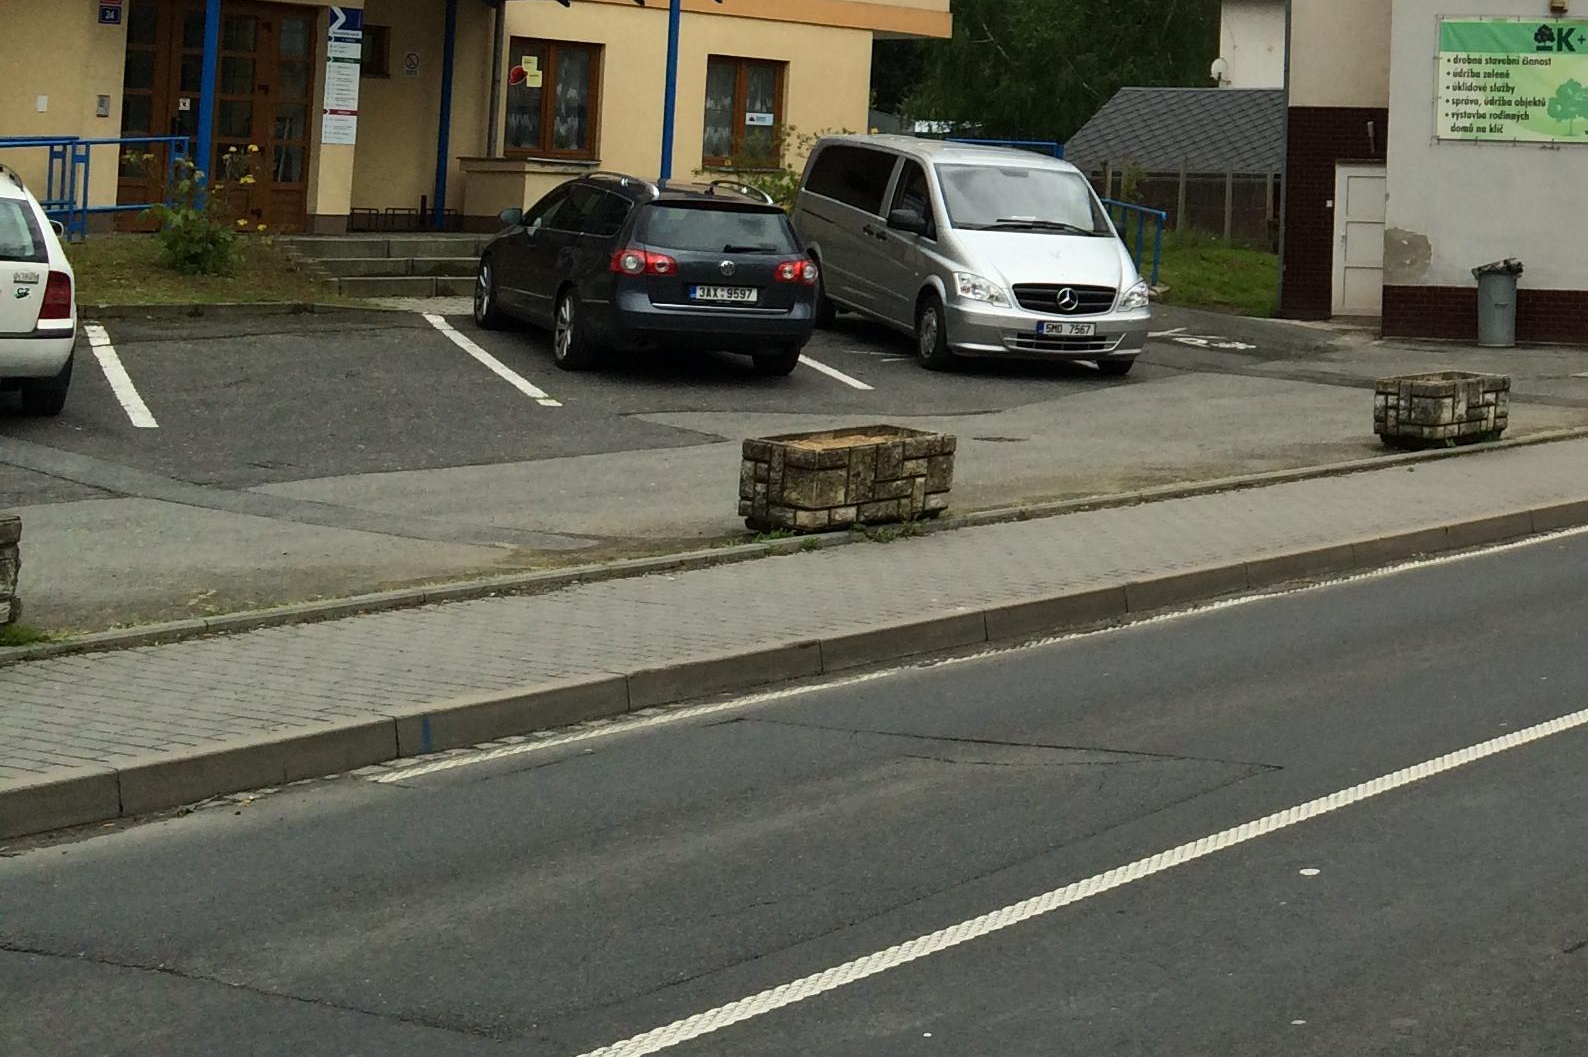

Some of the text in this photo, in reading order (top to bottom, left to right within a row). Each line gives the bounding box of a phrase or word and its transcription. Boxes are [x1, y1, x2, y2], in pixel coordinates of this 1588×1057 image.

[1514, 96, 1547, 109] objektů
[1476, 126, 1487, 134] na
[698, 286, 753, 300] 3AX 9597
[1069, 324, 1092, 335] 7567
